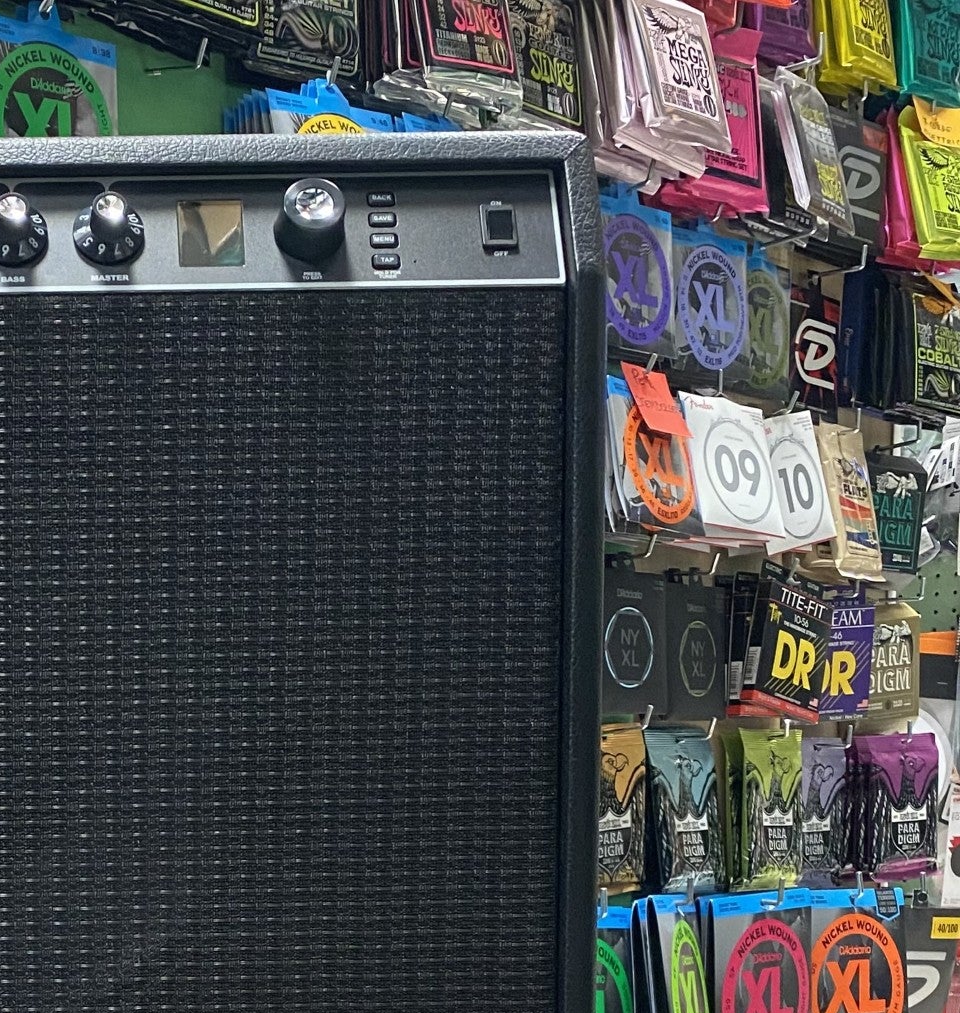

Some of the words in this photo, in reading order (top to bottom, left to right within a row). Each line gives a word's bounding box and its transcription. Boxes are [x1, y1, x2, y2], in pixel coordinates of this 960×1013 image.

[666, 37, 710, 69] MEGA
[5, 50, 46, 77] NICKEL
[50, 51, 95, 93] WOUND
[529, 47, 575, 92] SLINKY
[669, 56, 712, 96] SLINKY
[687, 250, 710, 272] NICKEL
[711, 249, 737, 279] WOUND
[0, 275, 26, 284] BASS
[90, 273, 130, 283] MASTER
[610, 251, 659, 308] XL
[692, 280, 736, 335] XL
[638, 431, 685, 486] XL
[715, 444, 761, 496] 09
[778, 463, 814, 514] 10
[878, 521, 912, 546] IGM
[781, 587, 828, 620] TITE-FIT
[793, 614, 810, 629] 10-56
[831, 610, 863, 627] EAM
[620, 629, 641, 646] NY
[621, 650, 640, 668] XL
[771, 630, 816, 691] DR
[691, 661, 707, 678] XL
[768, 828, 788, 840] PARA
[897, 822, 920, 834] PARA
[599, 831, 624, 845] PARA
[682, 832, 704, 845] PARA
[768, 839, 788, 851] DIGM
[804, 833, 824, 844] PARA
[897, 834, 920, 845] DIGM
[598, 844, 624, 859] DIGM
[683, 844, 706, 857] DIGM
[804, 844, 825, 856] DIGM
[737, 926, 767, 958] NICKEL
[767, 923, 798, 953] WOUND
[821, 921, 854, 951] NICKEL
[856, 919, 890, 947] WOUND
[598, 945, 621, 977] OUND
